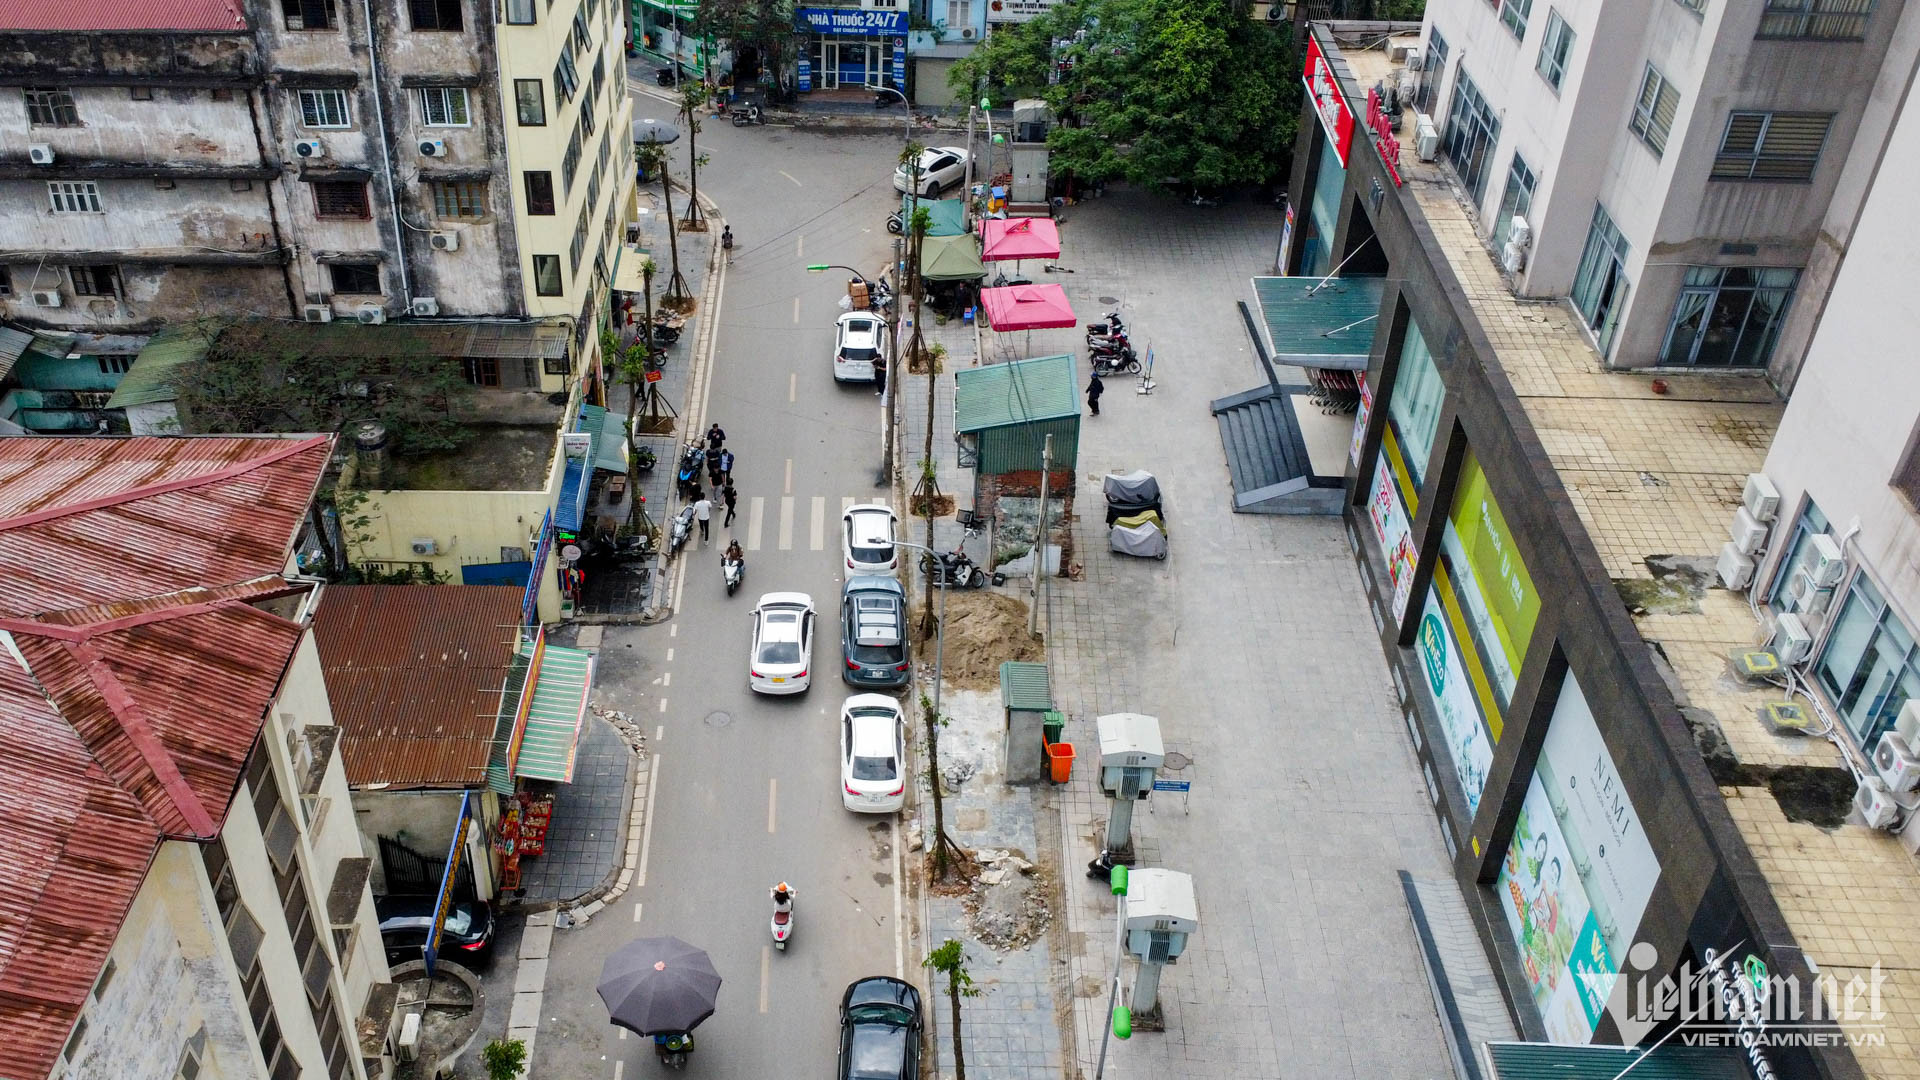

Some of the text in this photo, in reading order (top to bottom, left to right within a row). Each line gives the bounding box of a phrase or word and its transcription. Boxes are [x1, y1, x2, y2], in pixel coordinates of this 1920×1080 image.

[831, 11, 865, 26] THUỐC
[865, 12, 900, 27] 24/7
[1594, 753, 1631, 836] NEMI
[1705, 948, 1741, 1018] OFFICE
